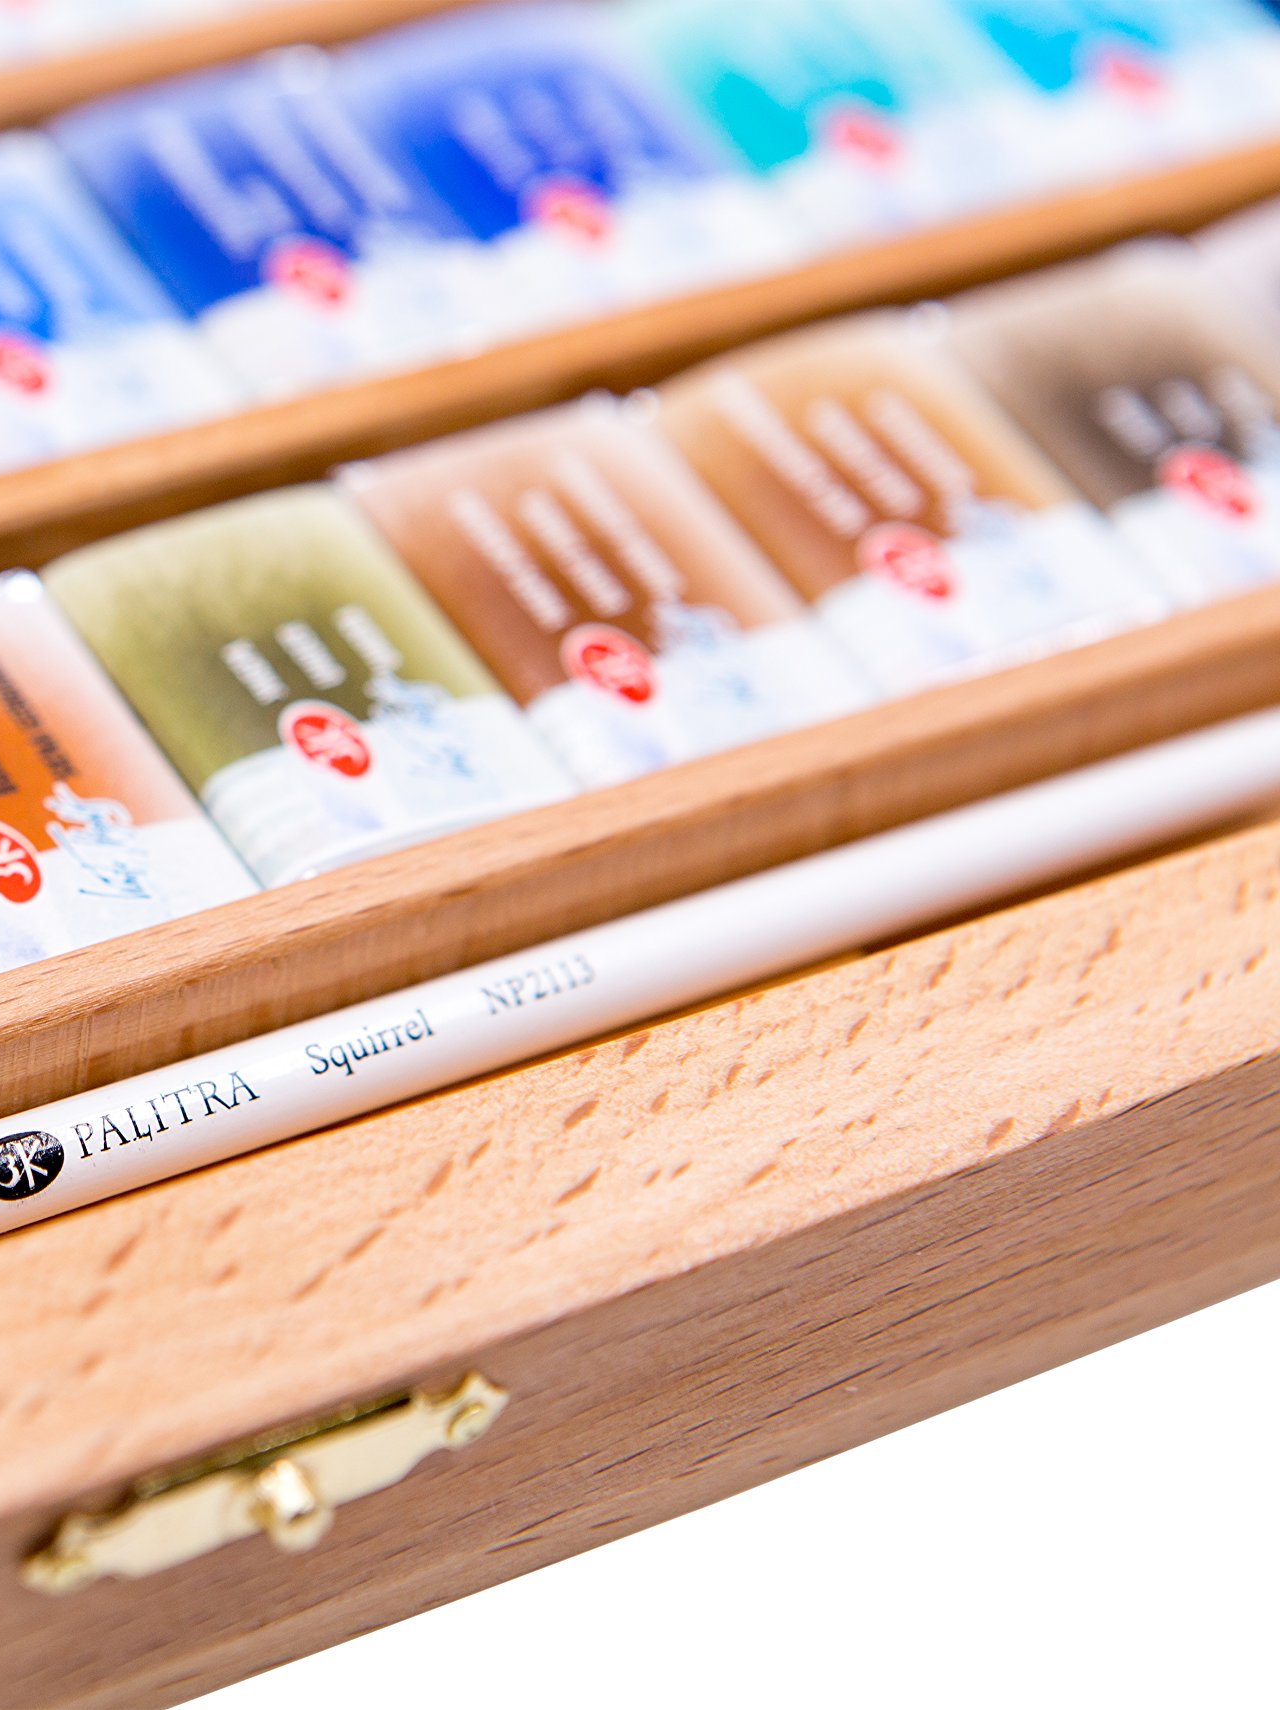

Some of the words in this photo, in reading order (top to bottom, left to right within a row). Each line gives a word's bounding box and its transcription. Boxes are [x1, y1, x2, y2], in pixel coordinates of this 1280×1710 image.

[69, 1070, 261, 1160] PALITRA
[305, 1008, 435, 1077] Squirrel
[479, 952, 596, 1016] NP2113
